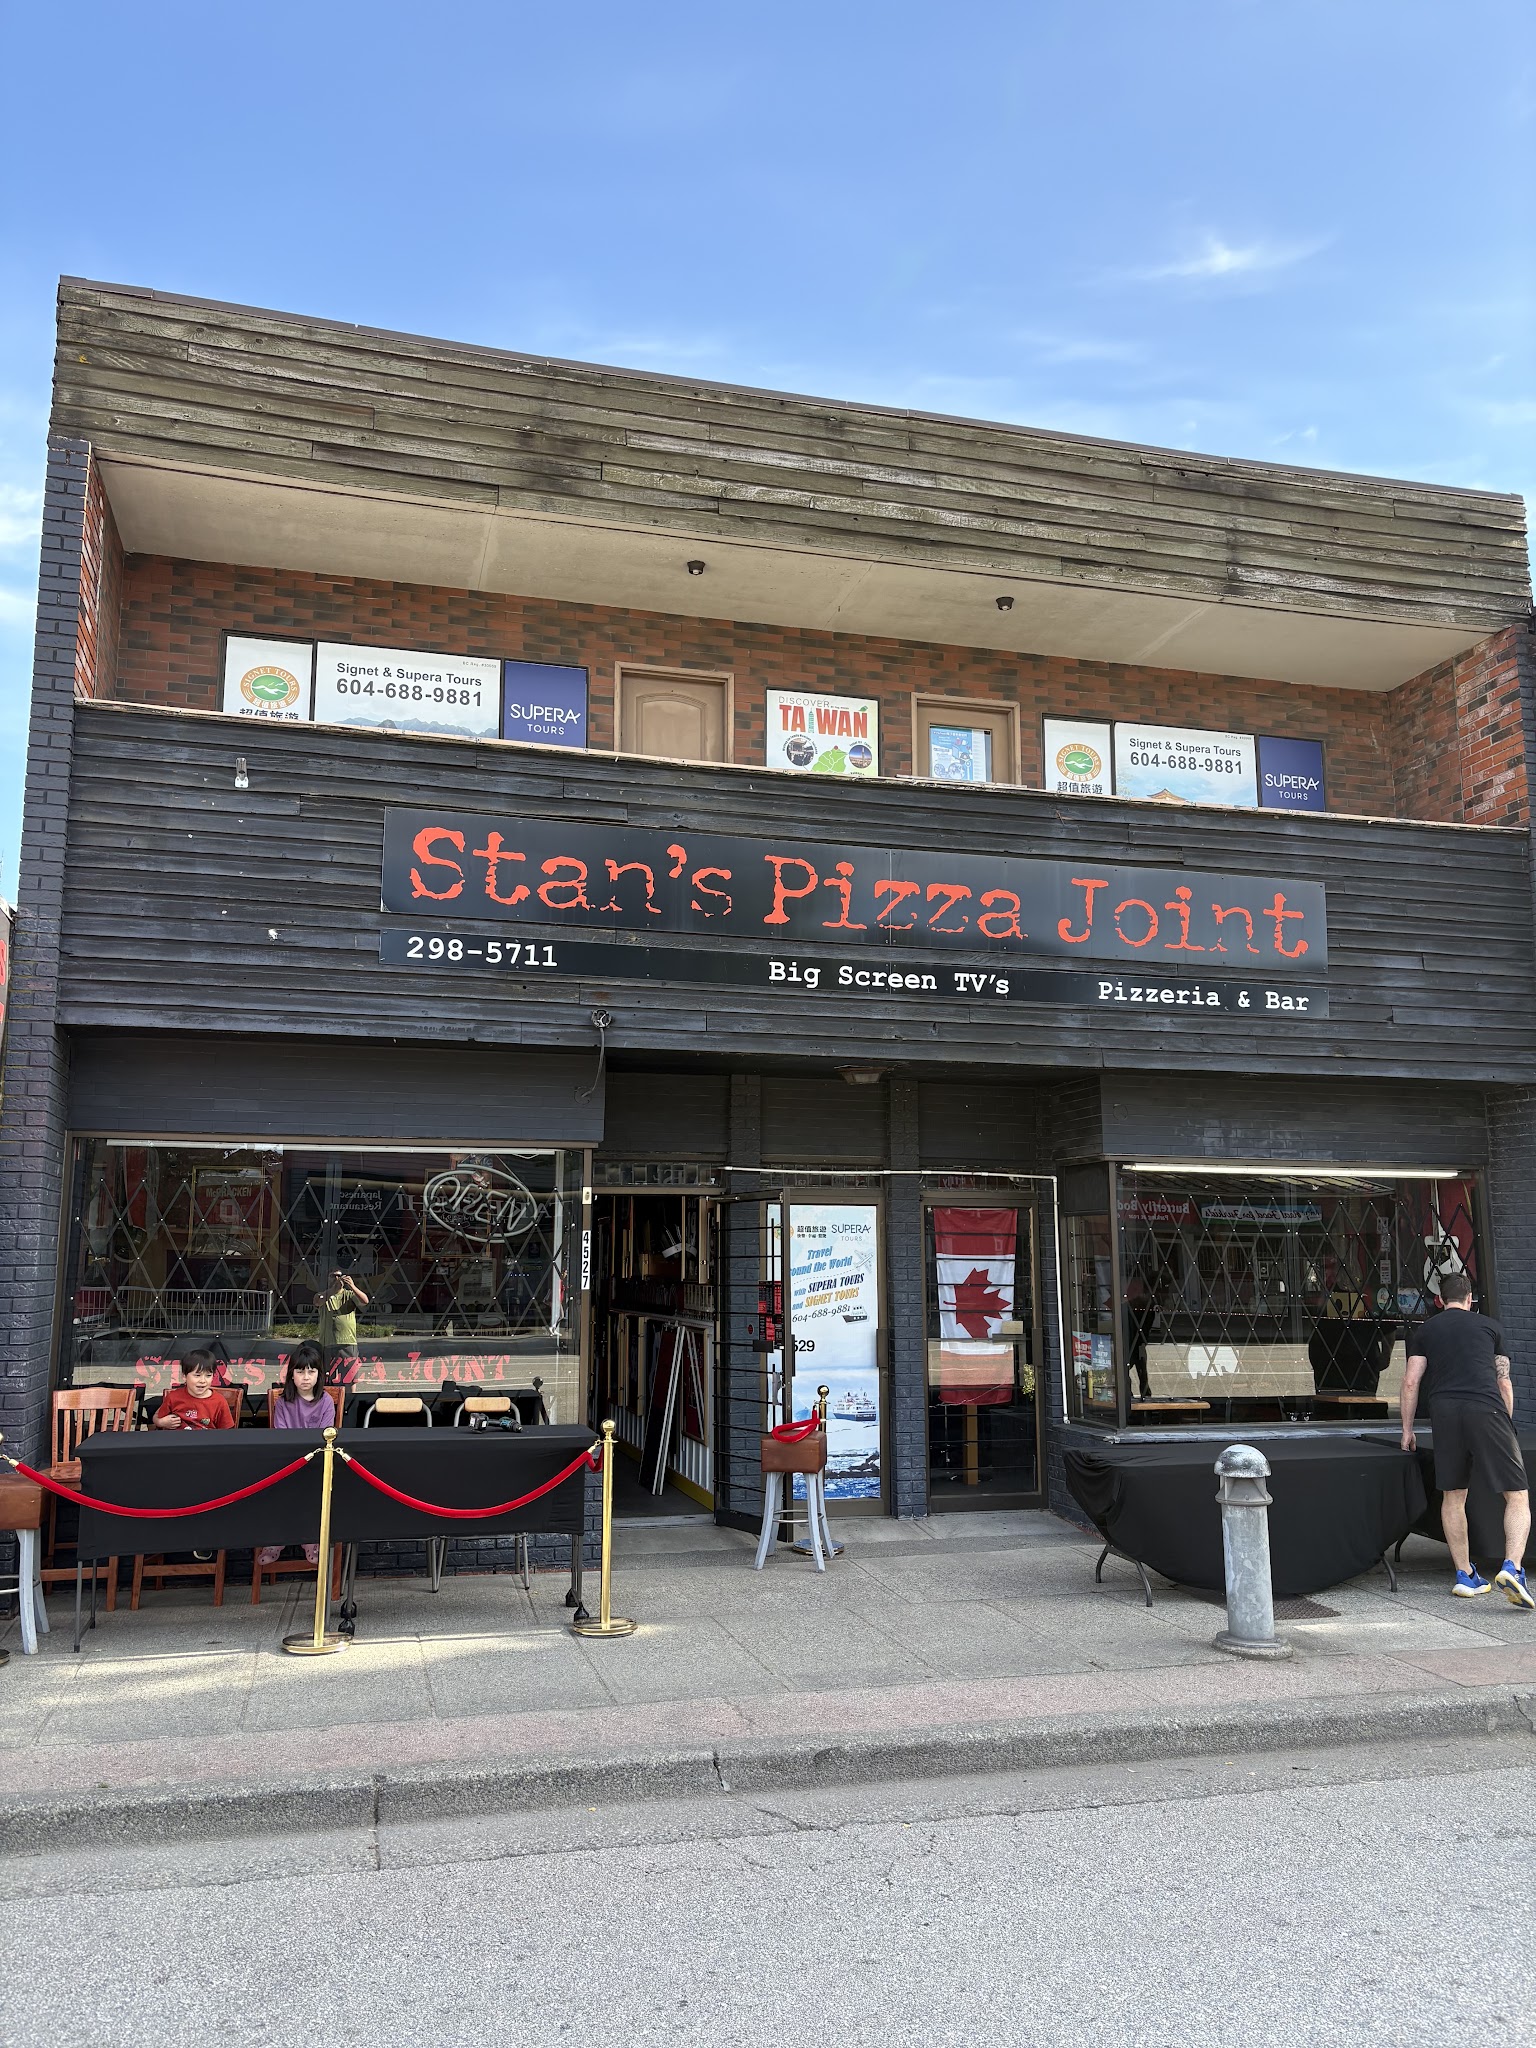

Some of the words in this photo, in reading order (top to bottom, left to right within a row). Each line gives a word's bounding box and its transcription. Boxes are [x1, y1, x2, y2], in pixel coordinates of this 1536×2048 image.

[243, 667, 272, 688] SIGNET
[275, 668, 298, 692] TOURS
[337, 662, 379, 676] Signet
[383, 667, 392, 677] &
[396, 668, 442, 682] Supera
[446, 673, 482, 686] Tours
[336, 678, 481, 706] 604-688-9881
[778, 696, 830, 708] DISCOVER
[510, 703, 581, 724] SUPERA
[527, 724, 565, 735] TOURS
[1058, 745, 1079, 763] SIGNET
[1129, 738, 1162, 750] Signet
[1164, 741, 1172, 751] &
[1175, 742, 1211, 754] Supera
[1213, 746, 1241, 757] Tours
[1130, 752, 1242, 775] 604-688-9881
[1265, 773, 1320, 790] SUPERA
[1279, 790, 1308, 801] TOURS
[410, 827, 732, 917] Stan's
[764, 855, 1028, 940] Pizza
[1057, 878, 1309, 958] Joint
[407, 936, 558, 967] 298-5711
[769, 961, 819, 987] Big
[838, 964, 938, 991] Screen
[954, 972, 1010, 995] TV's
[1098, 981, 1221, 1008] Pizzeria
[1237, 991, 1251, 1008] &
[1264, 991, 1310, 1012] Bar
[831, 1223, 871, 1234] SUPERA
[807, 1246, 833, 1260] Travel
[813, 1261, 827, 1273] the
[829, 1256, 853, 1269] World
[808, 1278, 837, 1293] SUPERA
[840, 1273, 865, 1287] TOURS
[792, 1302, 804, 1311] and
[805, 1292, 833, 1308] SIGNET
[834, 1287, 860, 1301] TOURS
[792, 1304, 851, 1323] 604-688-9881
